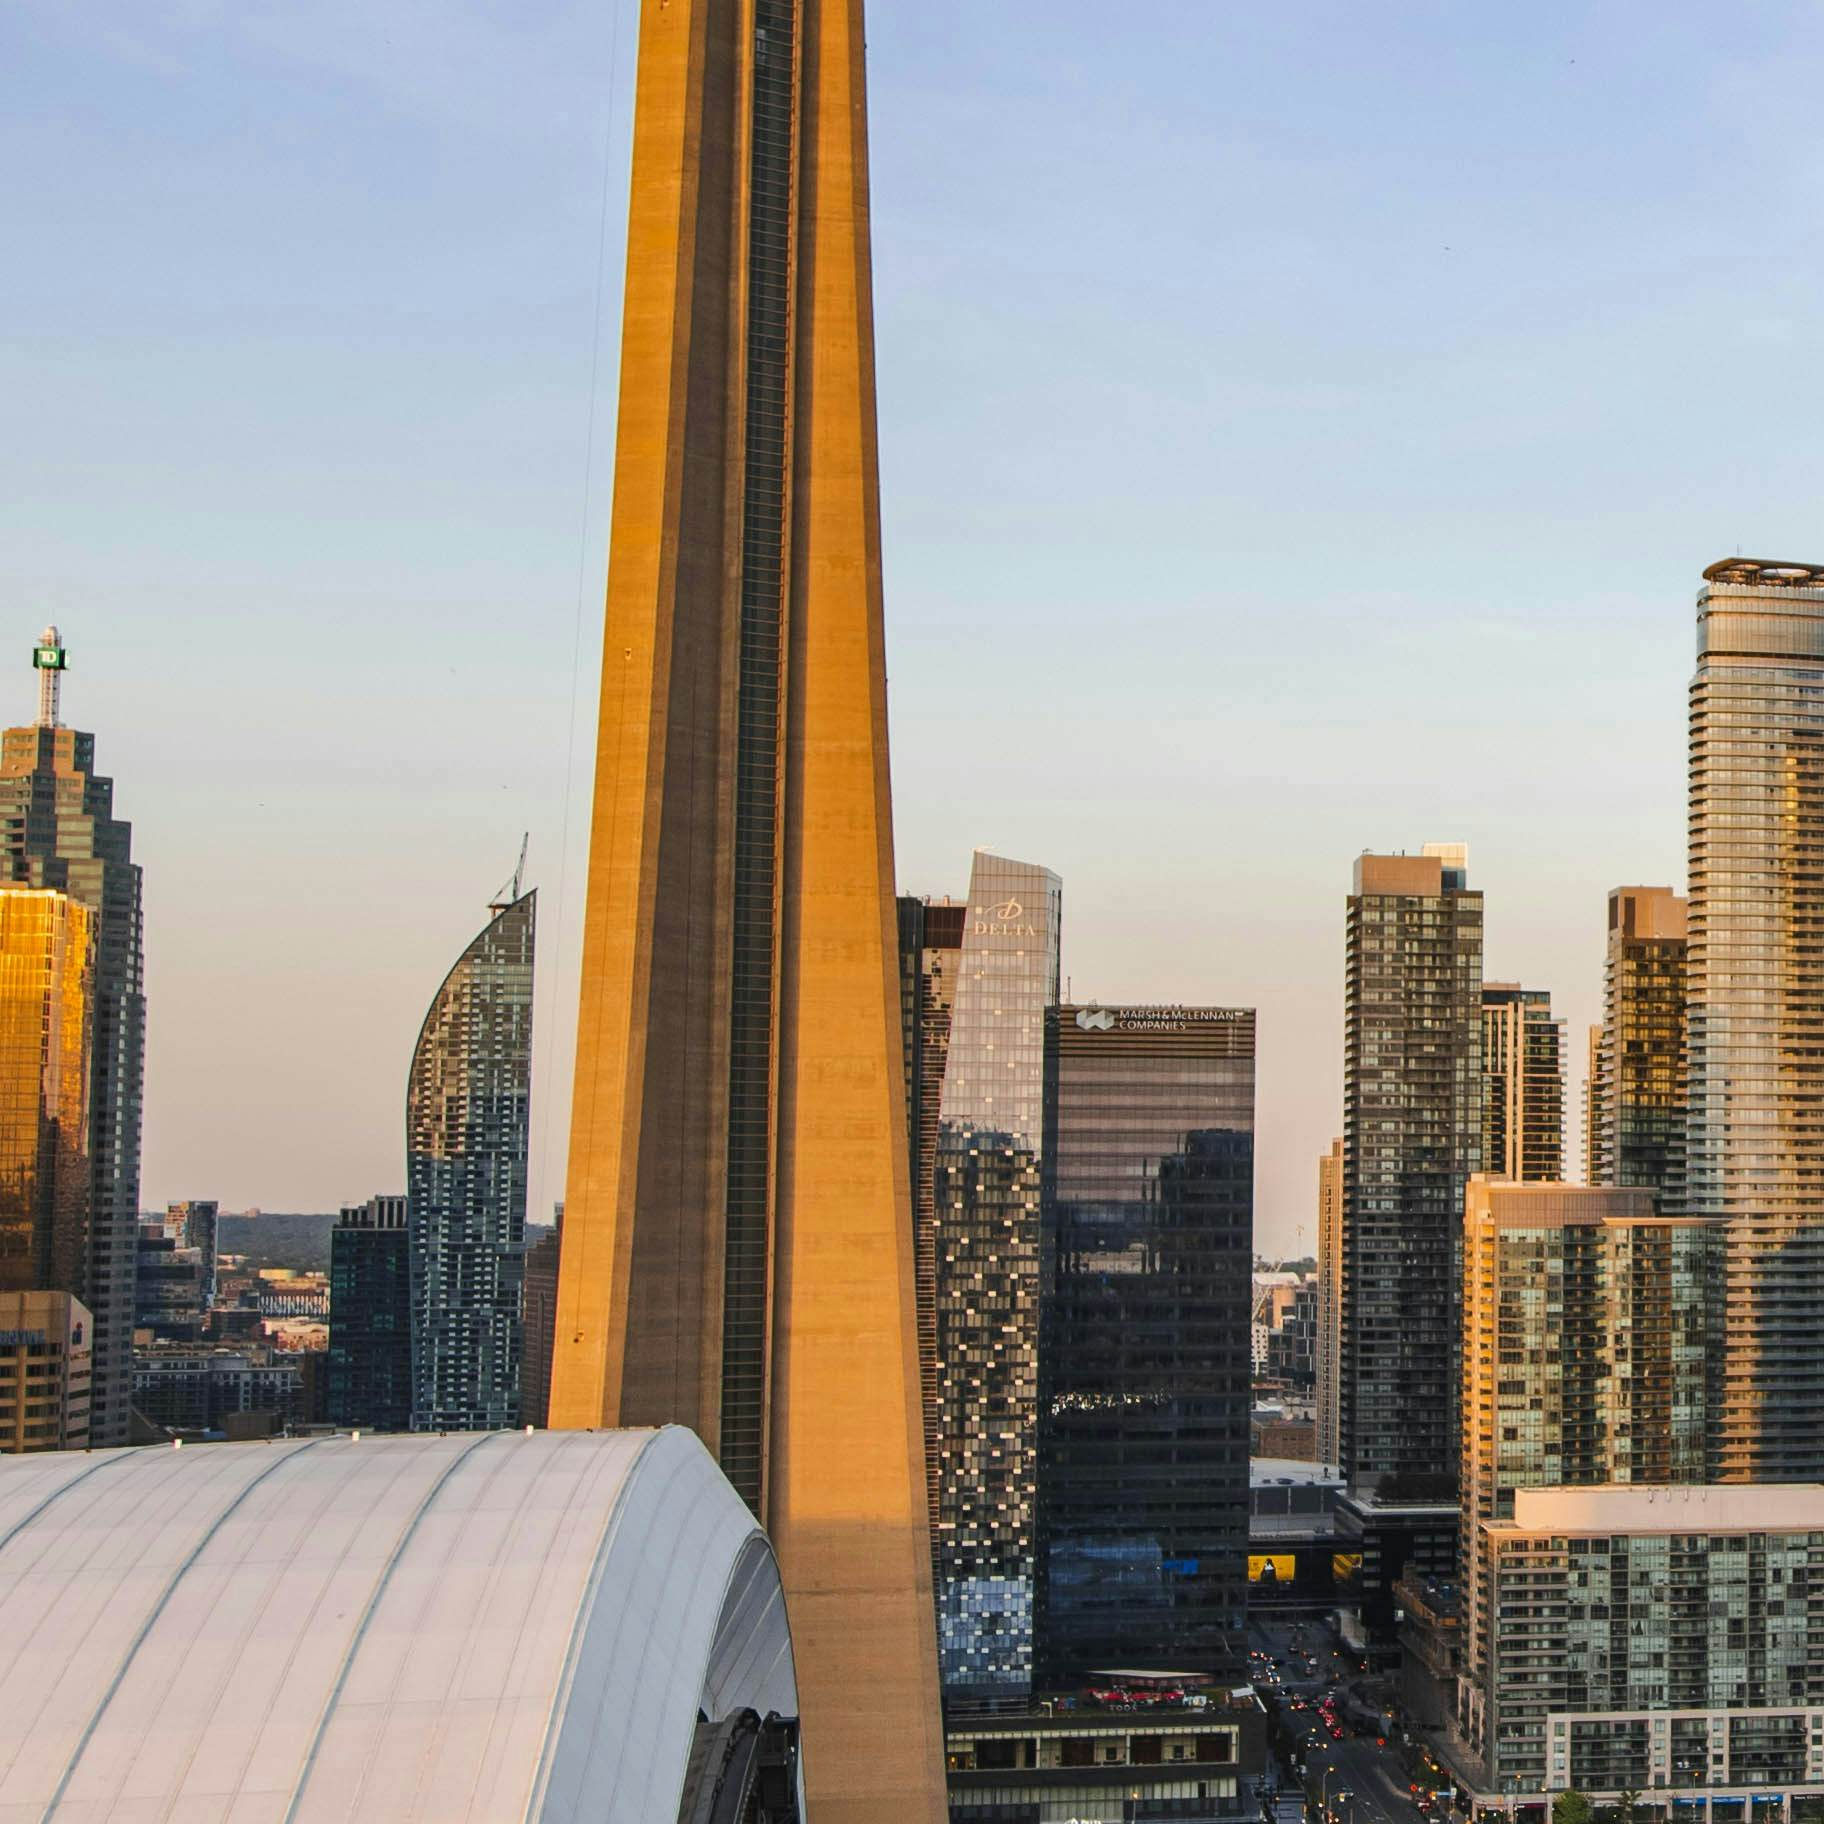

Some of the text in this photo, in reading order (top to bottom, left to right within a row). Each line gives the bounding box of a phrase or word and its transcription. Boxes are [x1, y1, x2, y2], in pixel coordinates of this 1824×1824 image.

[40, 650, 57, 663] TD
[975, 921, 1035, 936] DELTA
[1120, 1009, 1160, 1020] MARSH
[1119, 1020, 1186, 1031] COMPANIES
